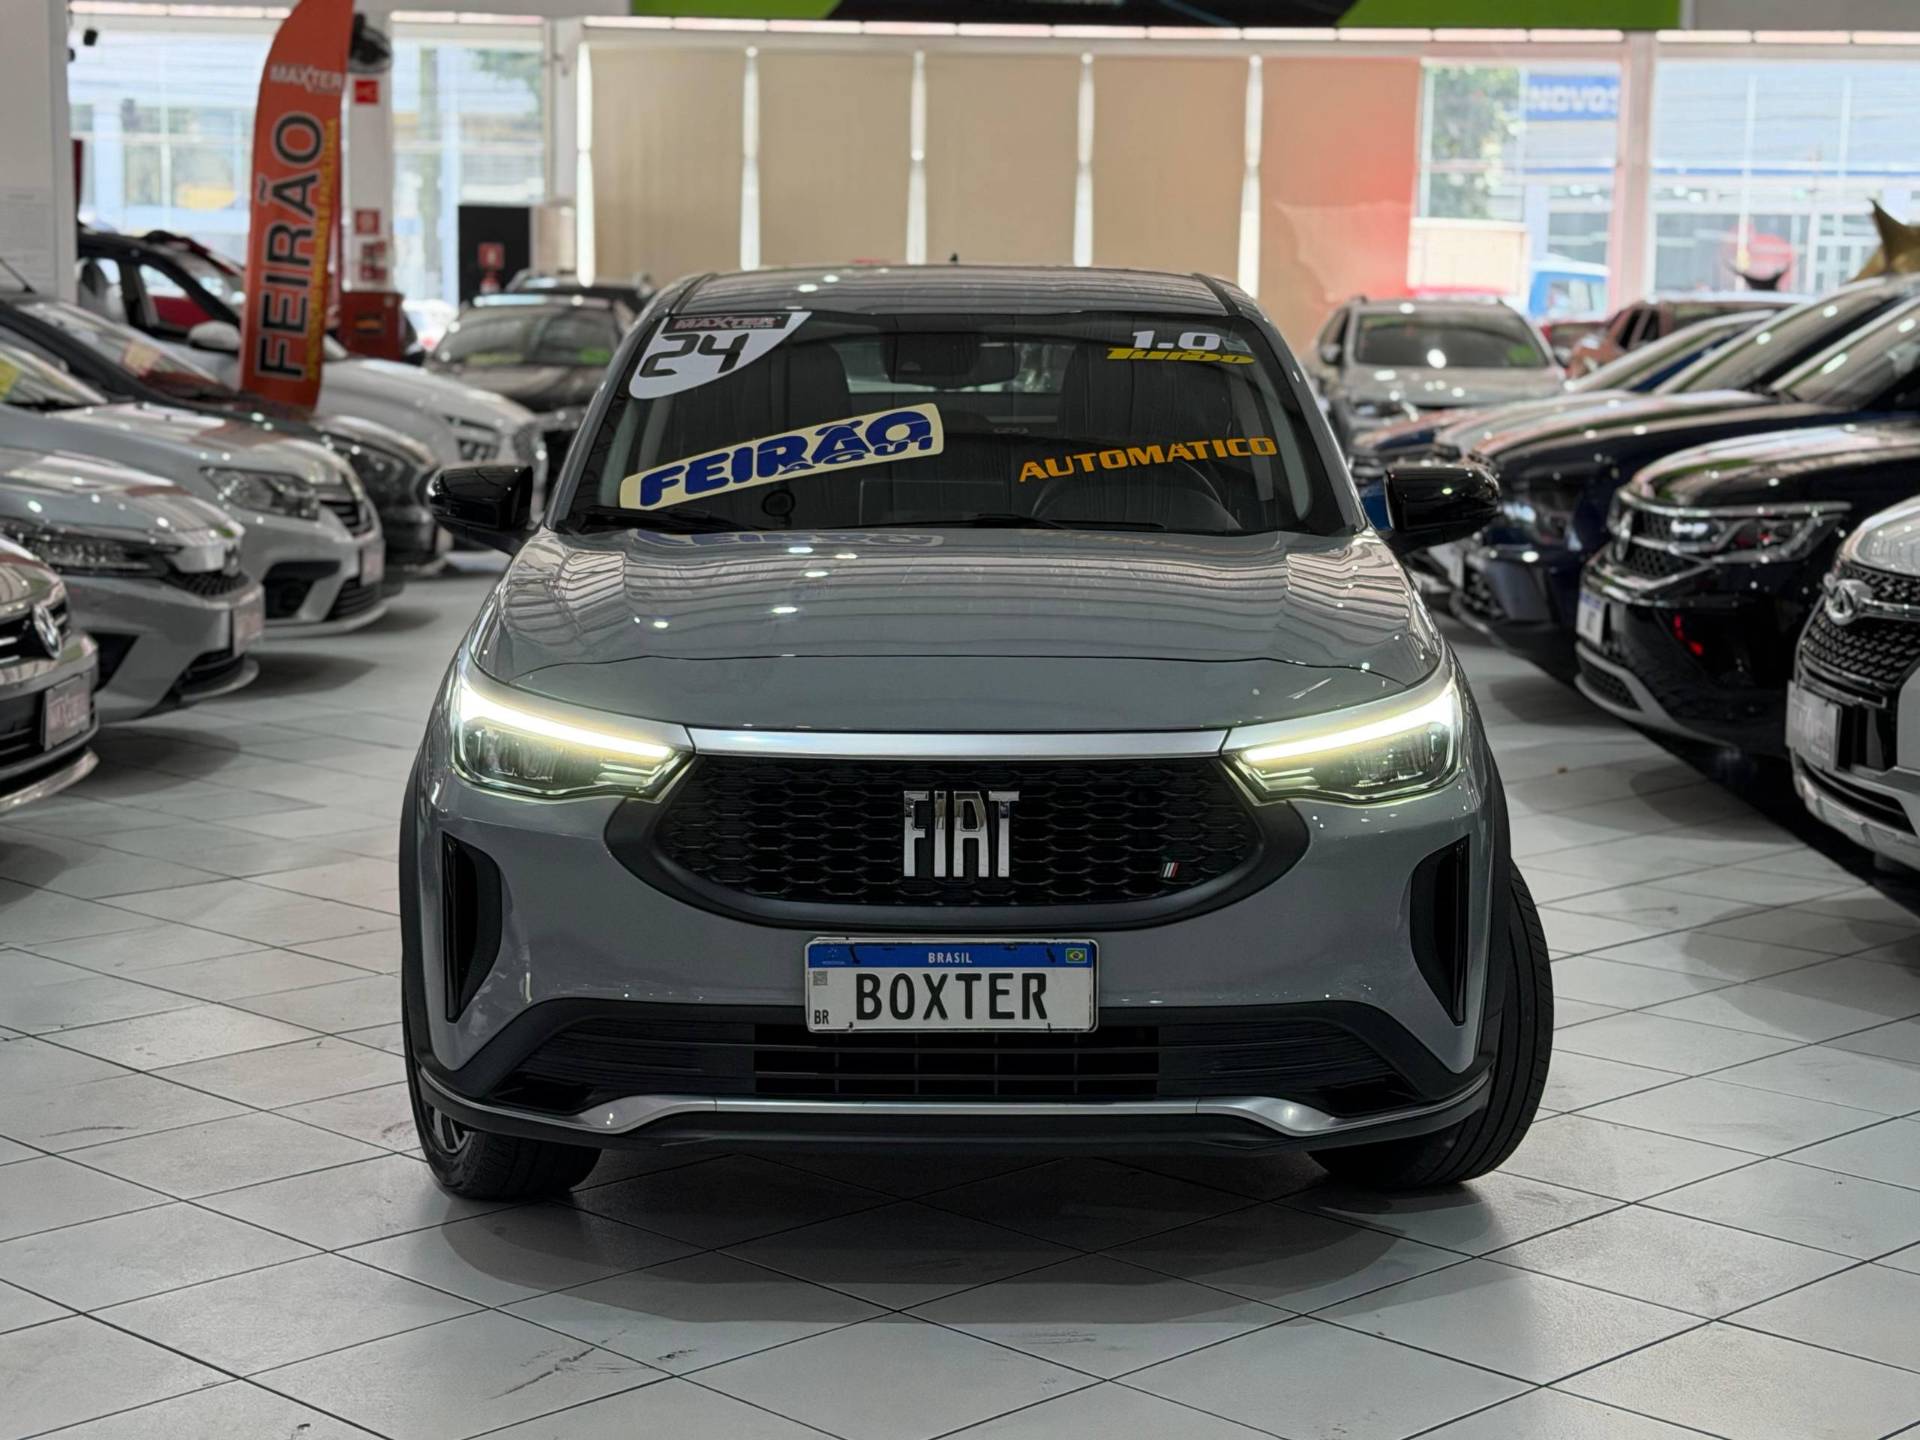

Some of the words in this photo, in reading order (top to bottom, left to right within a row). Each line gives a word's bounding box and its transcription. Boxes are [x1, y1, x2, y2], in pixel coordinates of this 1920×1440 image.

[258, 112, 324, 379] FEIRÃO
[639, 333, 750, 378] 24
[1132, 330, 1221, 350] 1.0
[640, 411, 932, 507] FEIRÃO
[904, 791, 1019, 877] FIAT
[928, 952, 973, 964] BRASIL
[814, 1010, 829, 1025] BR
[856, 973, 1048, 1020] BOXTER
